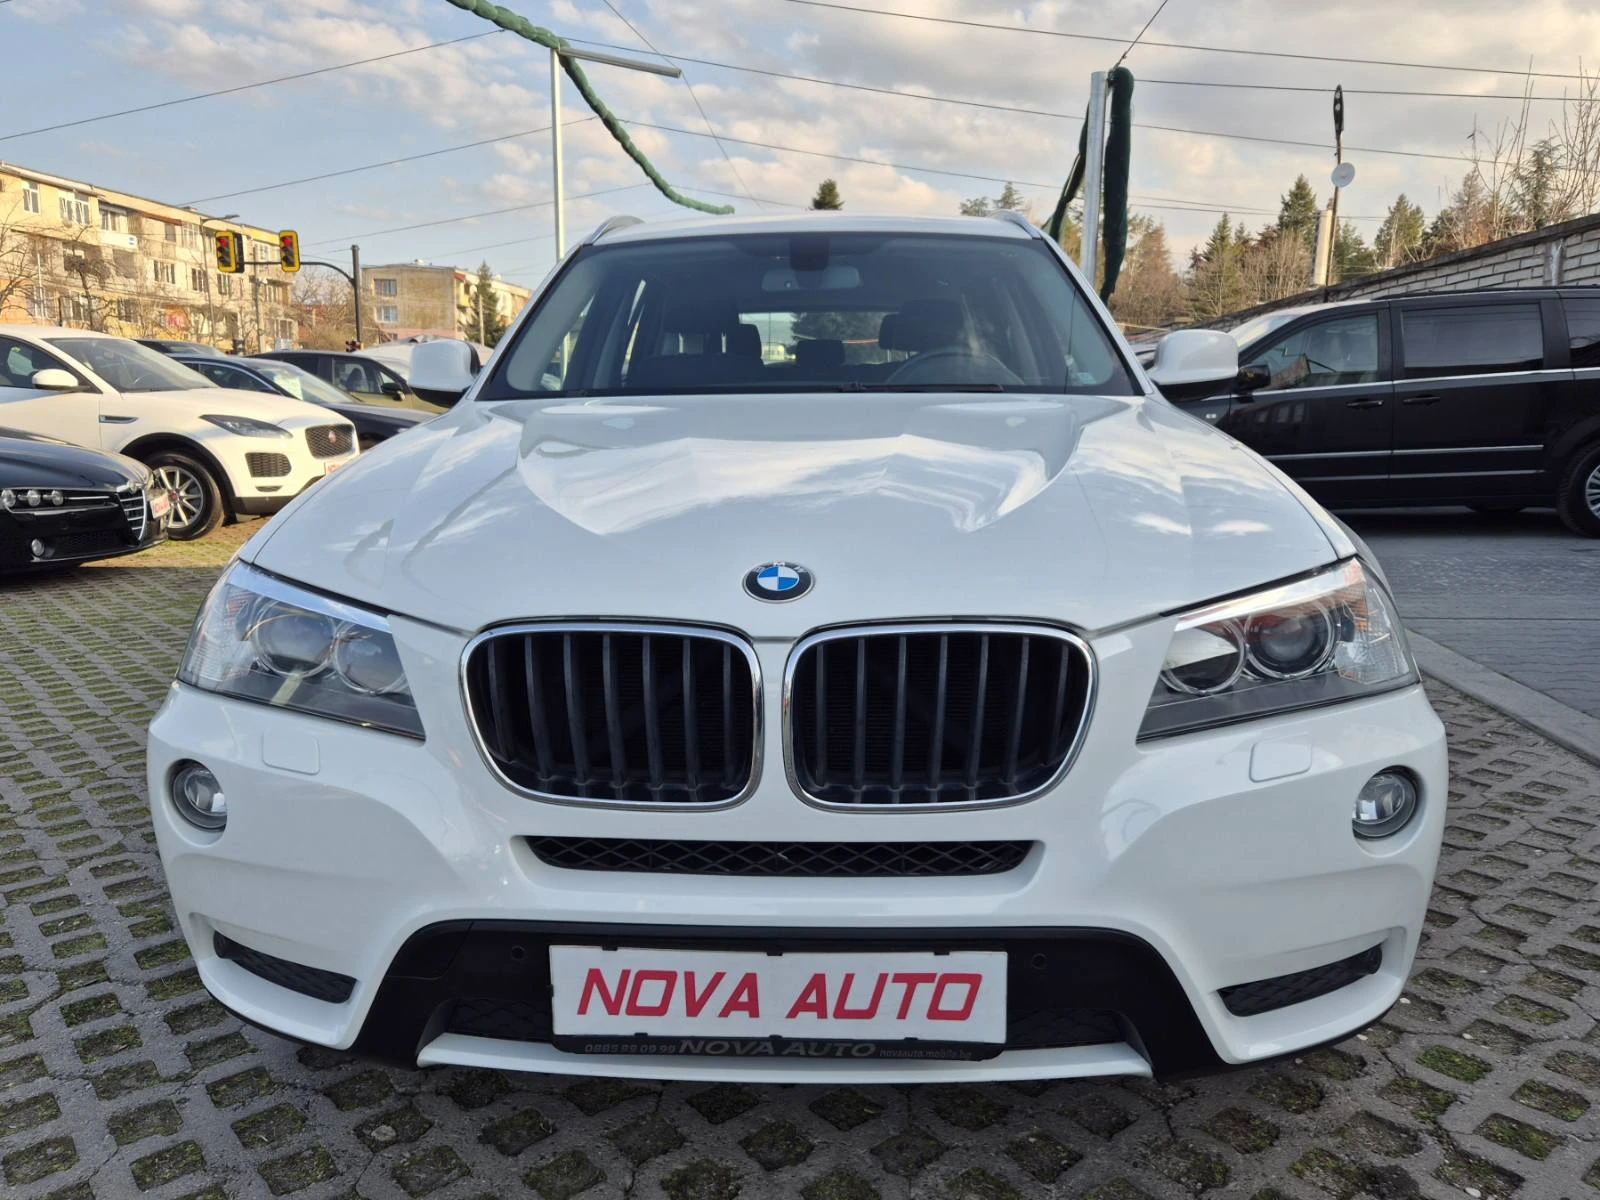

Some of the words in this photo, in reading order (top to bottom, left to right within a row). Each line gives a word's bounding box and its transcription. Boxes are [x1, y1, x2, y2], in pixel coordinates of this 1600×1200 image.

[577, 968, 760, 1018] NOVA
[785, 972, 983, 1021] AUTO
[678, 1040, 776, 1056] NOVA
[781, 1043, 876, 1057] AUTO
